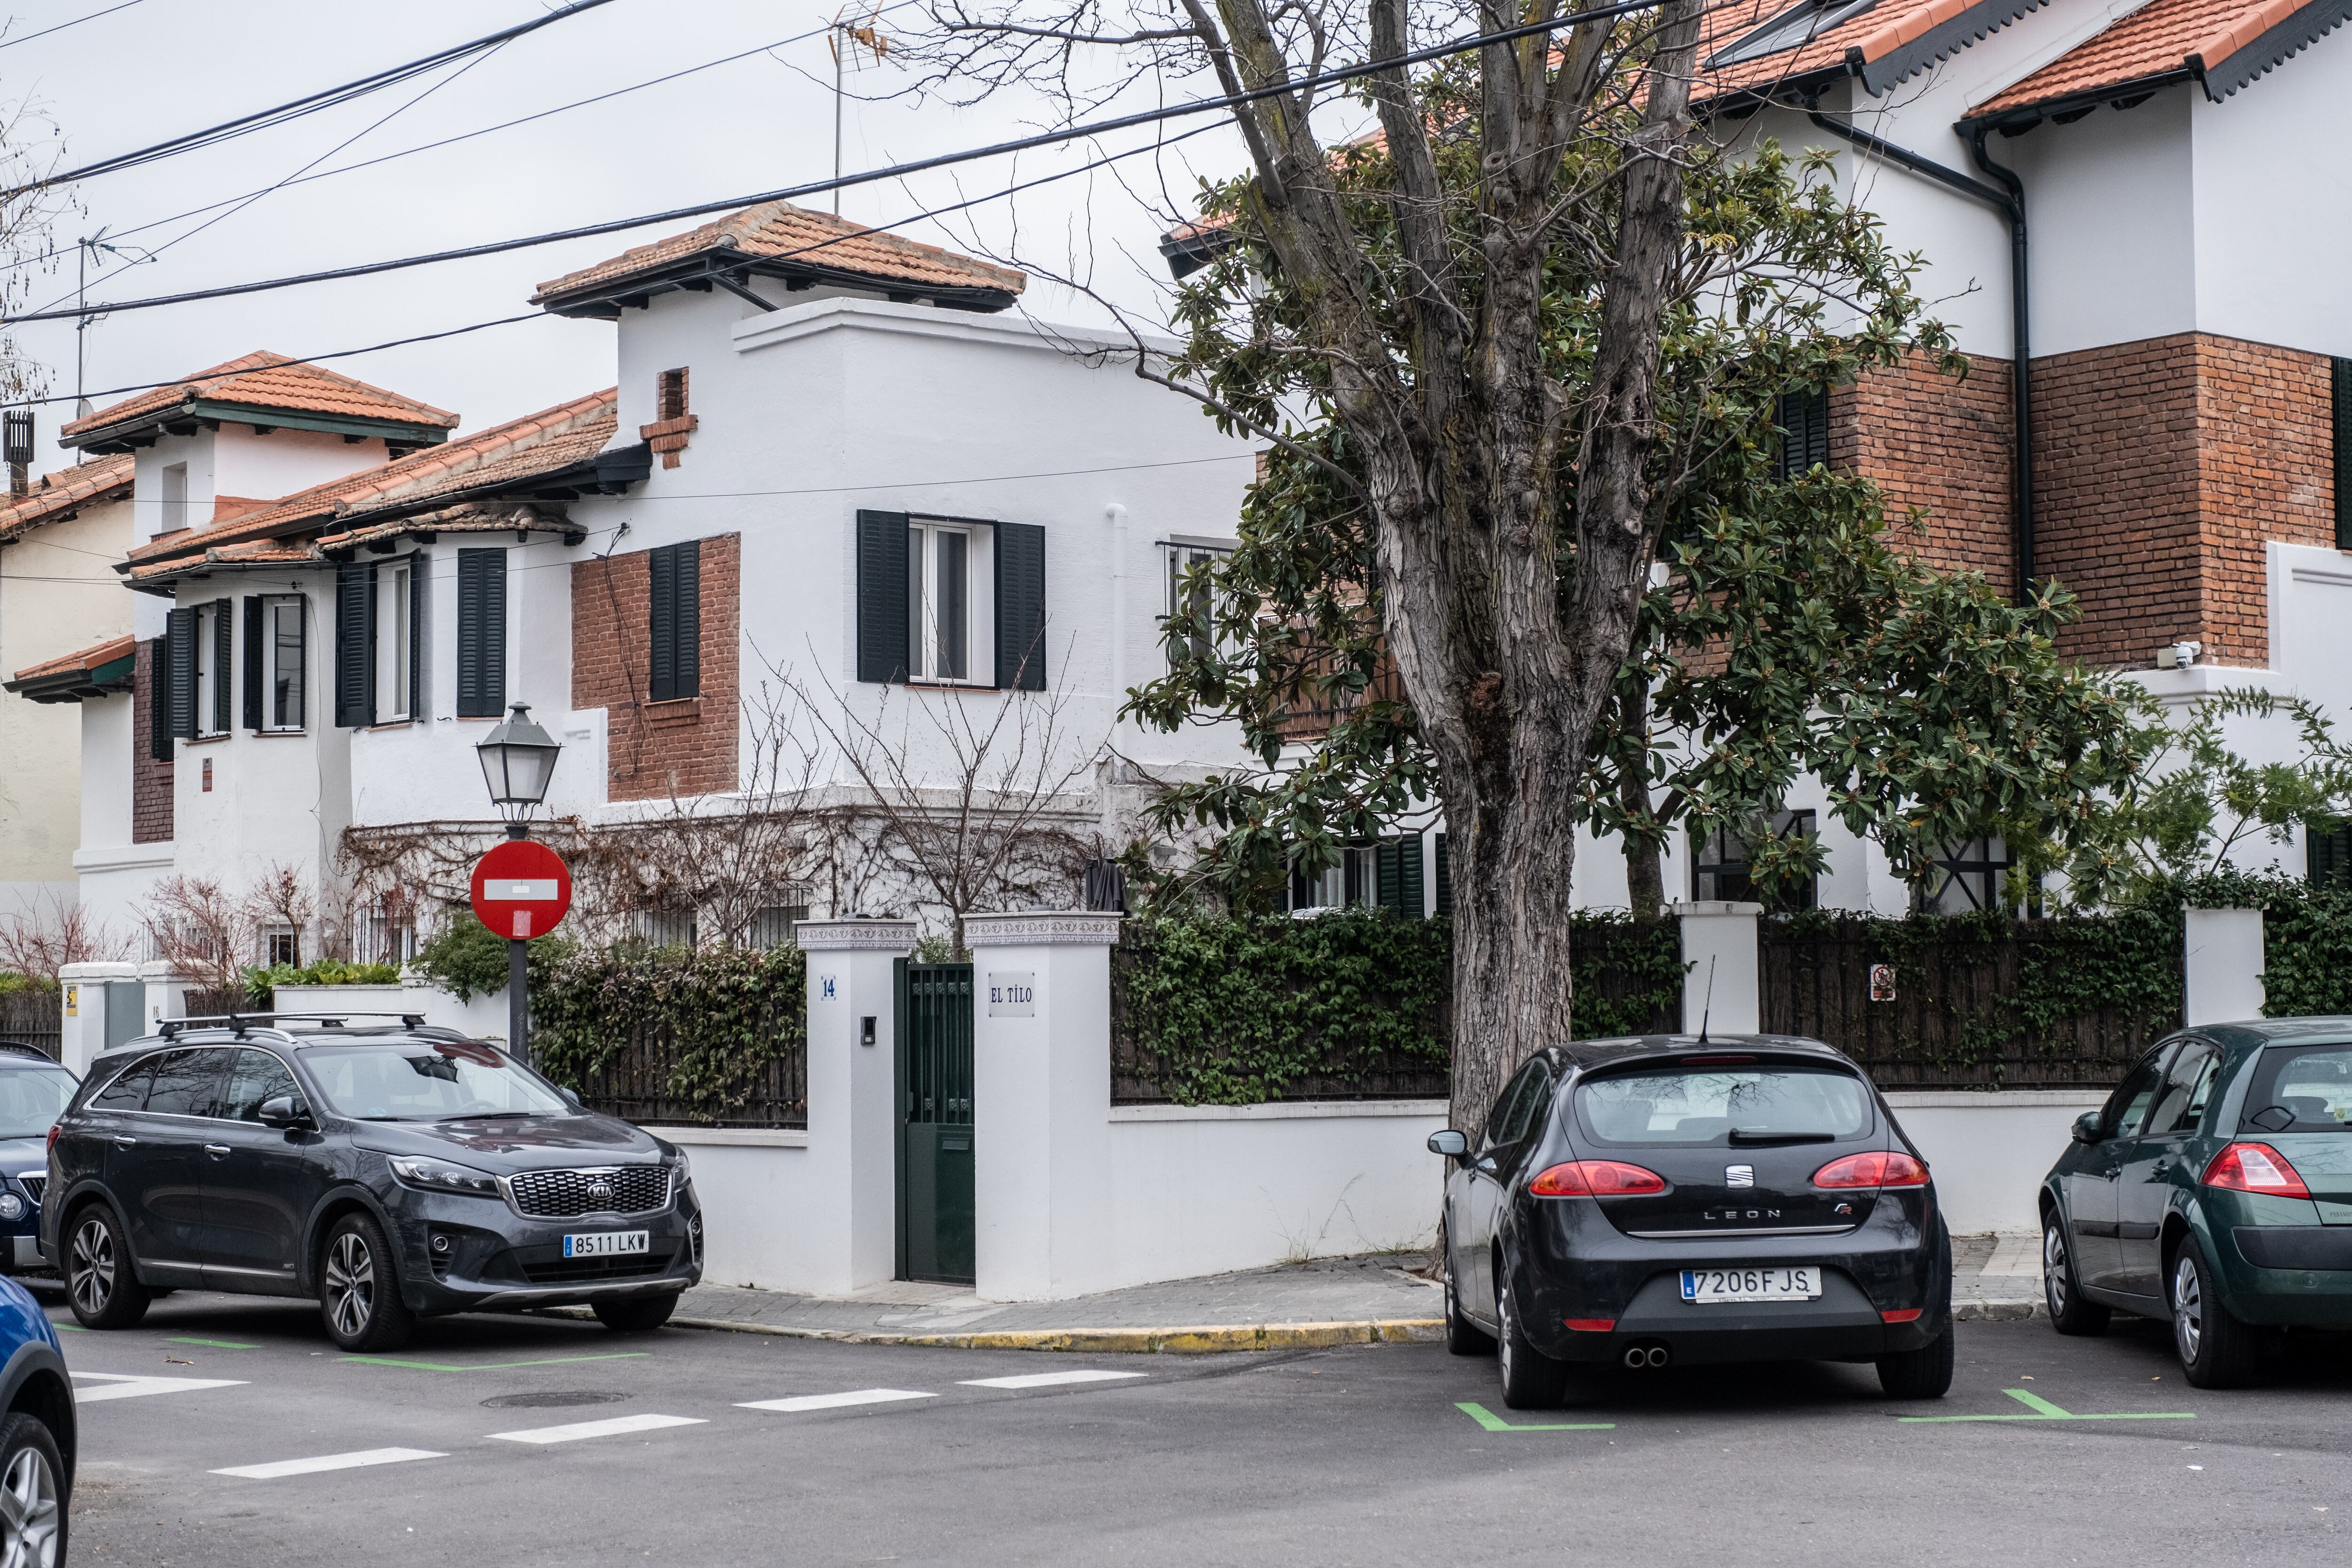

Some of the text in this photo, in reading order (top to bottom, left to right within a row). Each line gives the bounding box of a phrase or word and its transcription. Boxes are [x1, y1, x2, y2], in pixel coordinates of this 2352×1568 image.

[823, 979, 834, 997] 14
[992, 987, 1003, 1003] EL
[153, 1005, 159, 1018] 16
[593, 1186, 612, 1196] KIA
[1704, 1210, 1780, 1220] LEON
[576, 1237, 612, 1253] 8511
[619, 1234, 645, 1251] LKW
